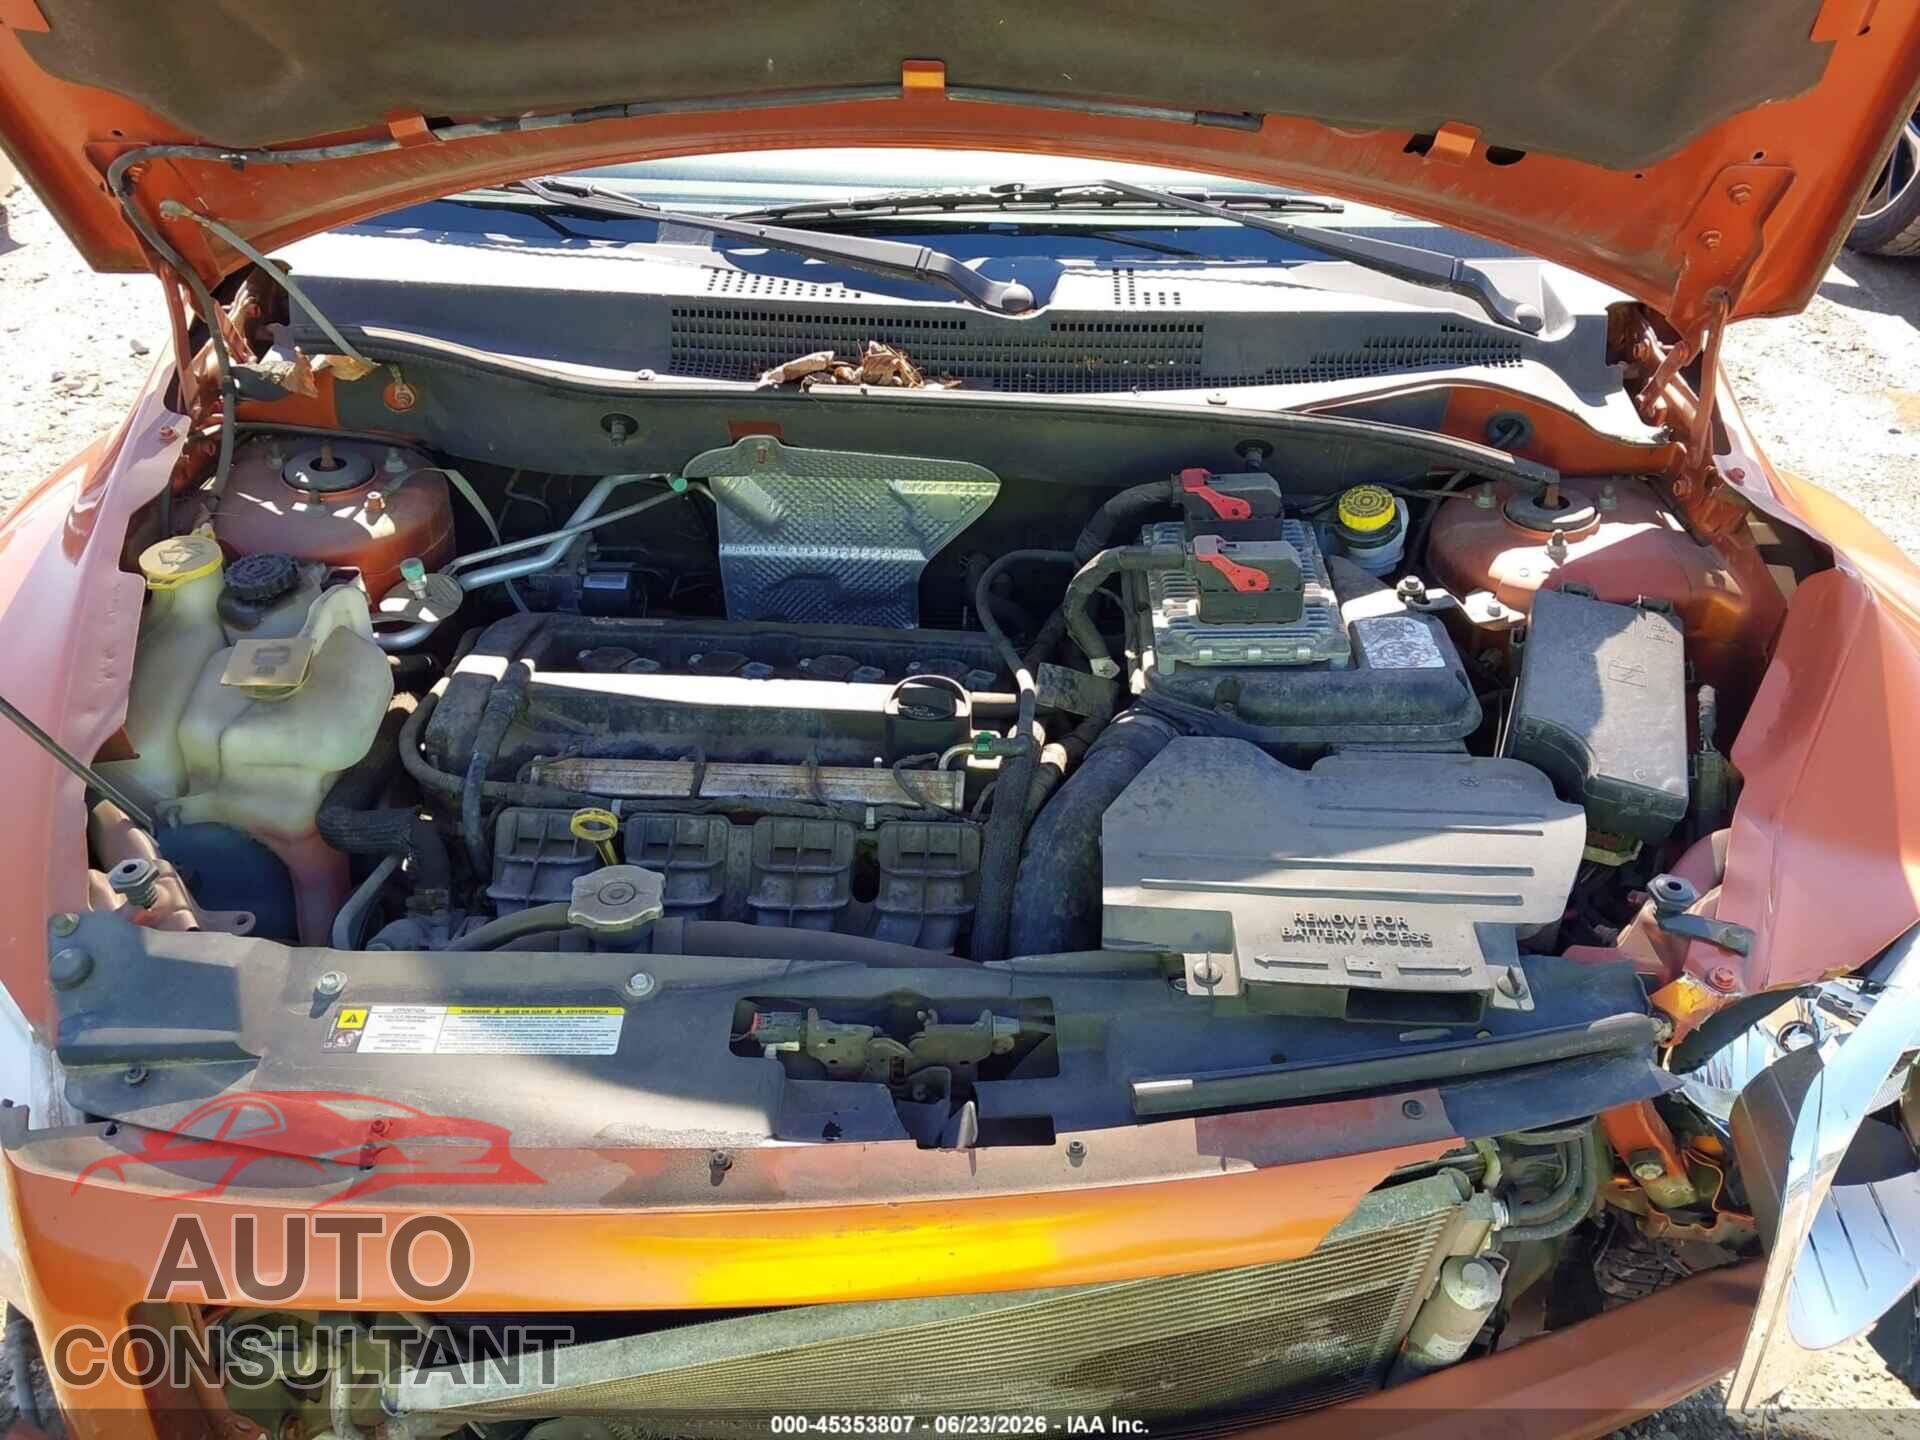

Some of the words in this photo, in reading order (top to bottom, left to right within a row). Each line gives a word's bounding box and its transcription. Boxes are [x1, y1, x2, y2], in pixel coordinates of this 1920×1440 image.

[1294, 912, 1369, 929] REMOVE
[1373, 914, 1409, 930] FOR
[1281, 927, 1356, 945] BATTERY
[1361, 930, 1433, 947] ACCESS
